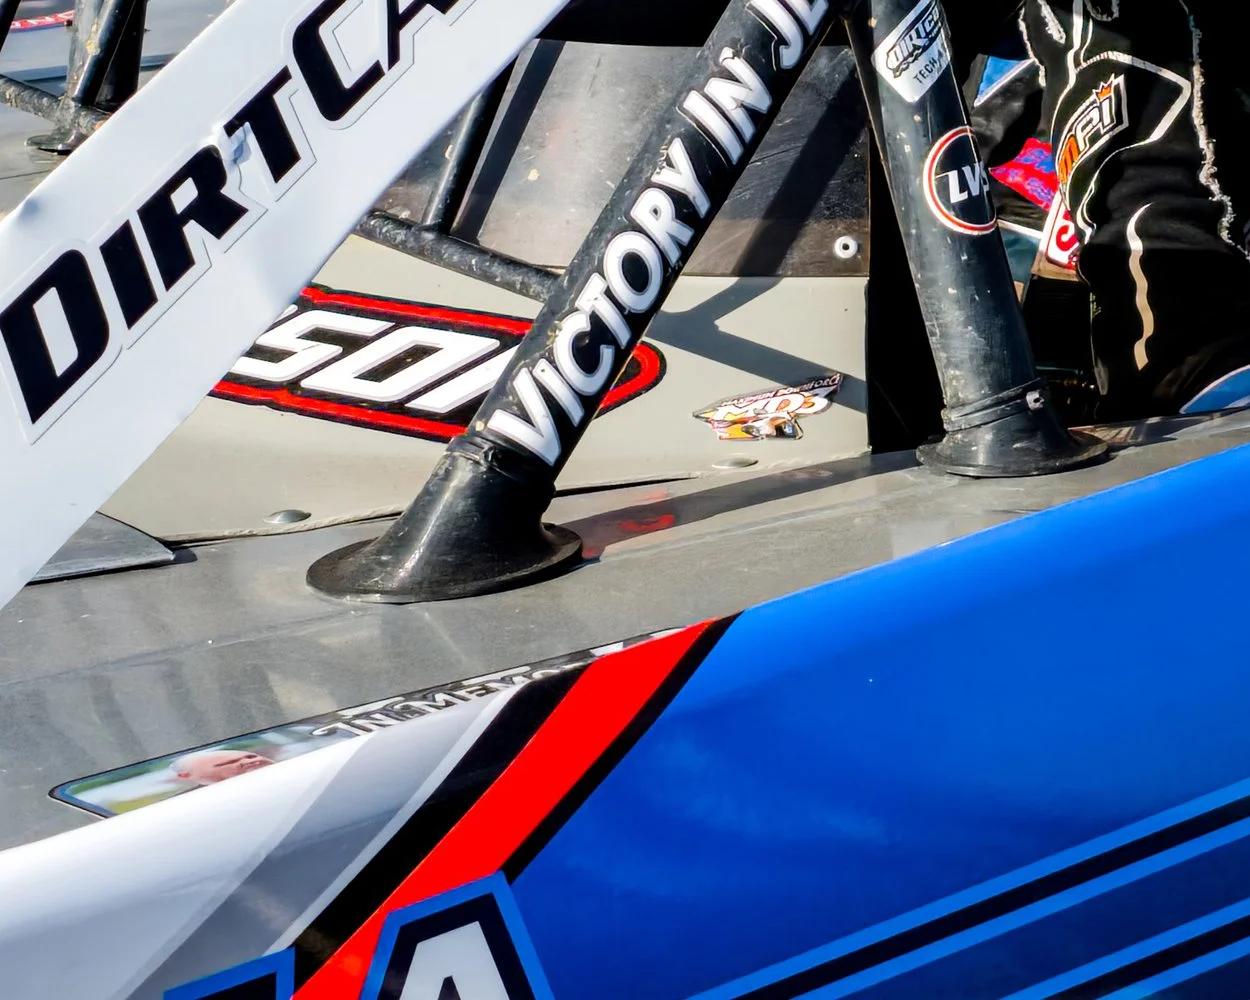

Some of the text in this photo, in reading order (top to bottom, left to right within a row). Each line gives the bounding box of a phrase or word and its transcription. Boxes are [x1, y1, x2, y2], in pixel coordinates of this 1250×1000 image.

[913, 57, 938, 84] TECH
[490, 137, 711, 467] VICTORY
[682, 47, 774, 166] IN
[711, 391, 830, 421] MD3
